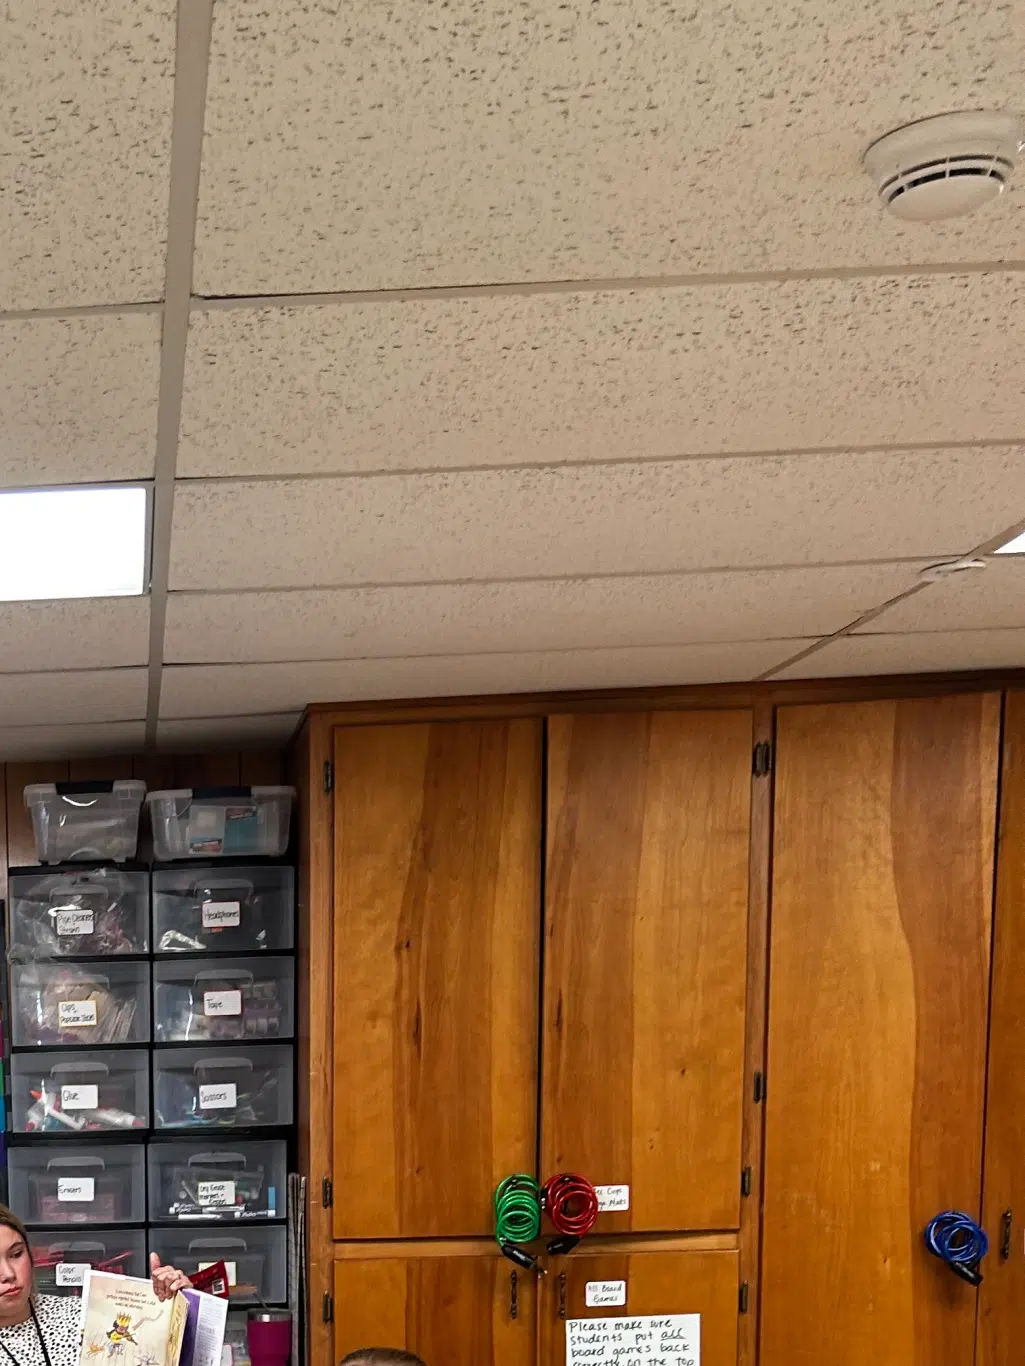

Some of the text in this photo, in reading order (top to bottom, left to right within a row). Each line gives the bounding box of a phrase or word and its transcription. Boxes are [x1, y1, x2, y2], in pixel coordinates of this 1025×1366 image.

[206, 998, 223, 1010] Tape
[63, 1090, 80, 1101] Glue
[569, 1319, 673, 1333] Please make sure
[570, 1328, 685, 1346] students put all
[571, 1342, 690, 1361] board games back
[647, 1356, 667, 1366] the
